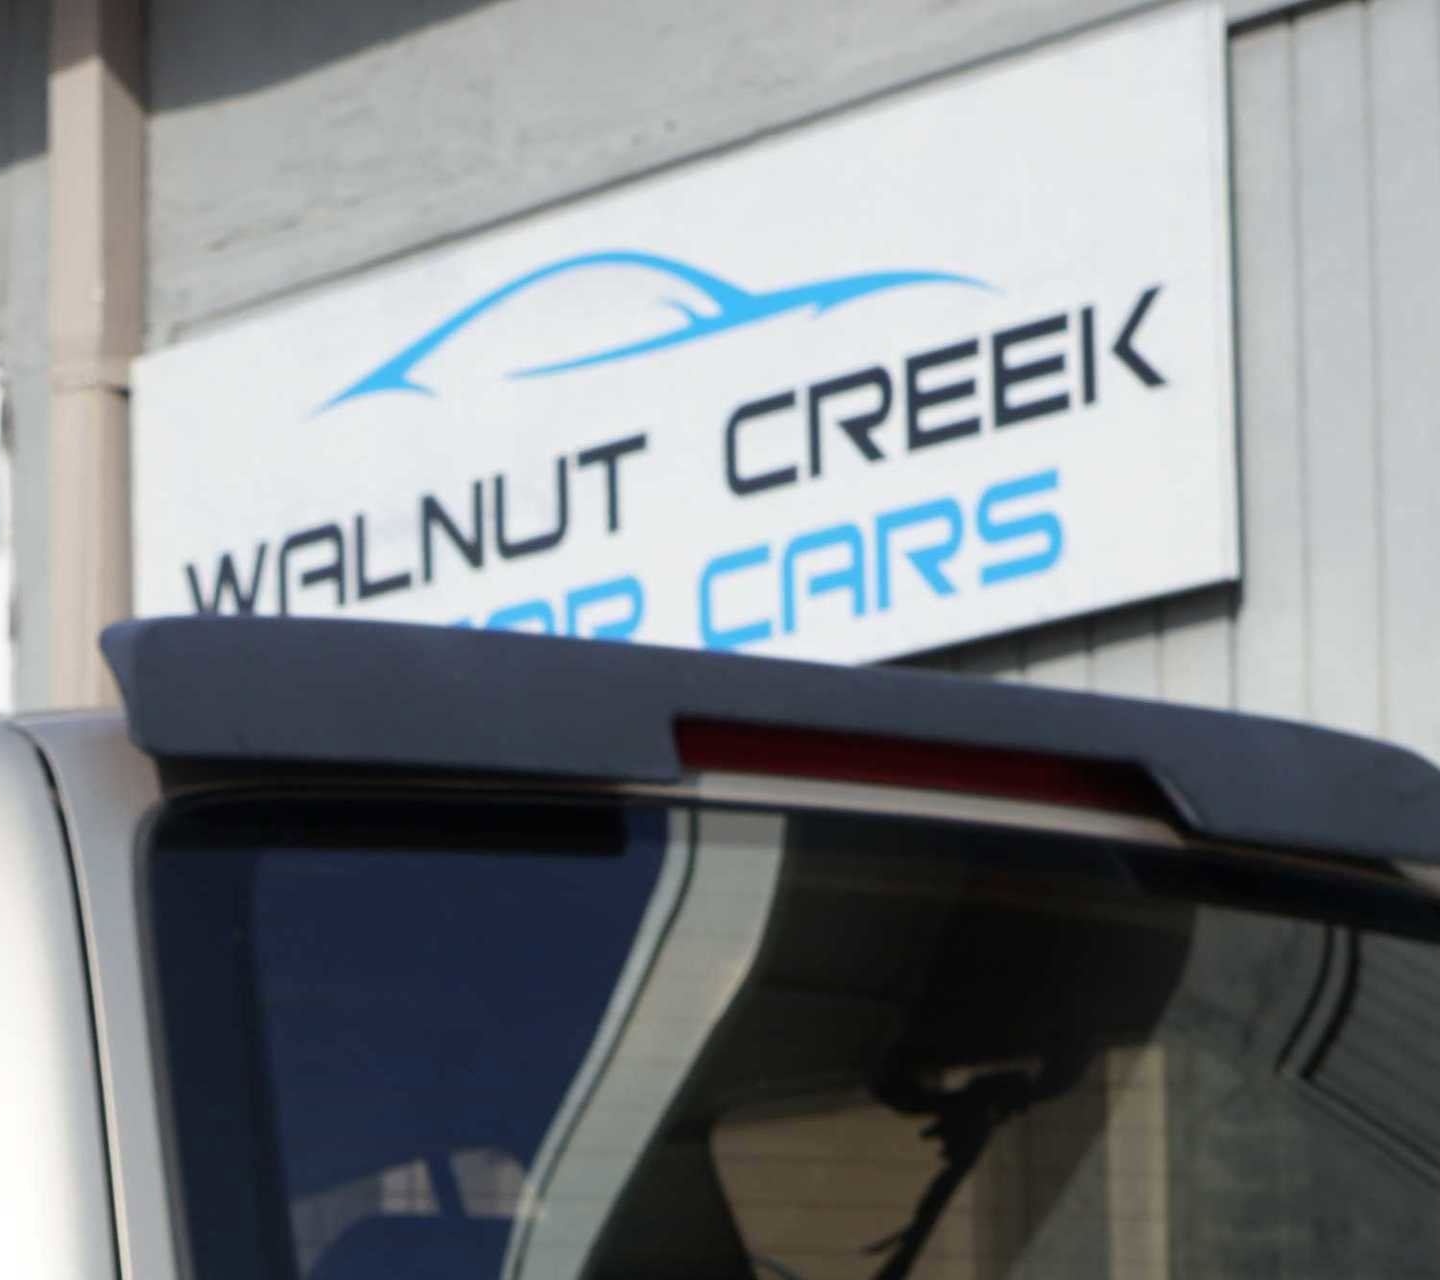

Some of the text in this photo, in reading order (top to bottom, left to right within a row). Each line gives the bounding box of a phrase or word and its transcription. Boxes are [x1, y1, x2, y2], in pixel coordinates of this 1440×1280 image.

[185, 283, 1168, 616] WALNUT CREEK
[697, 468, 1065, 653] CARS
